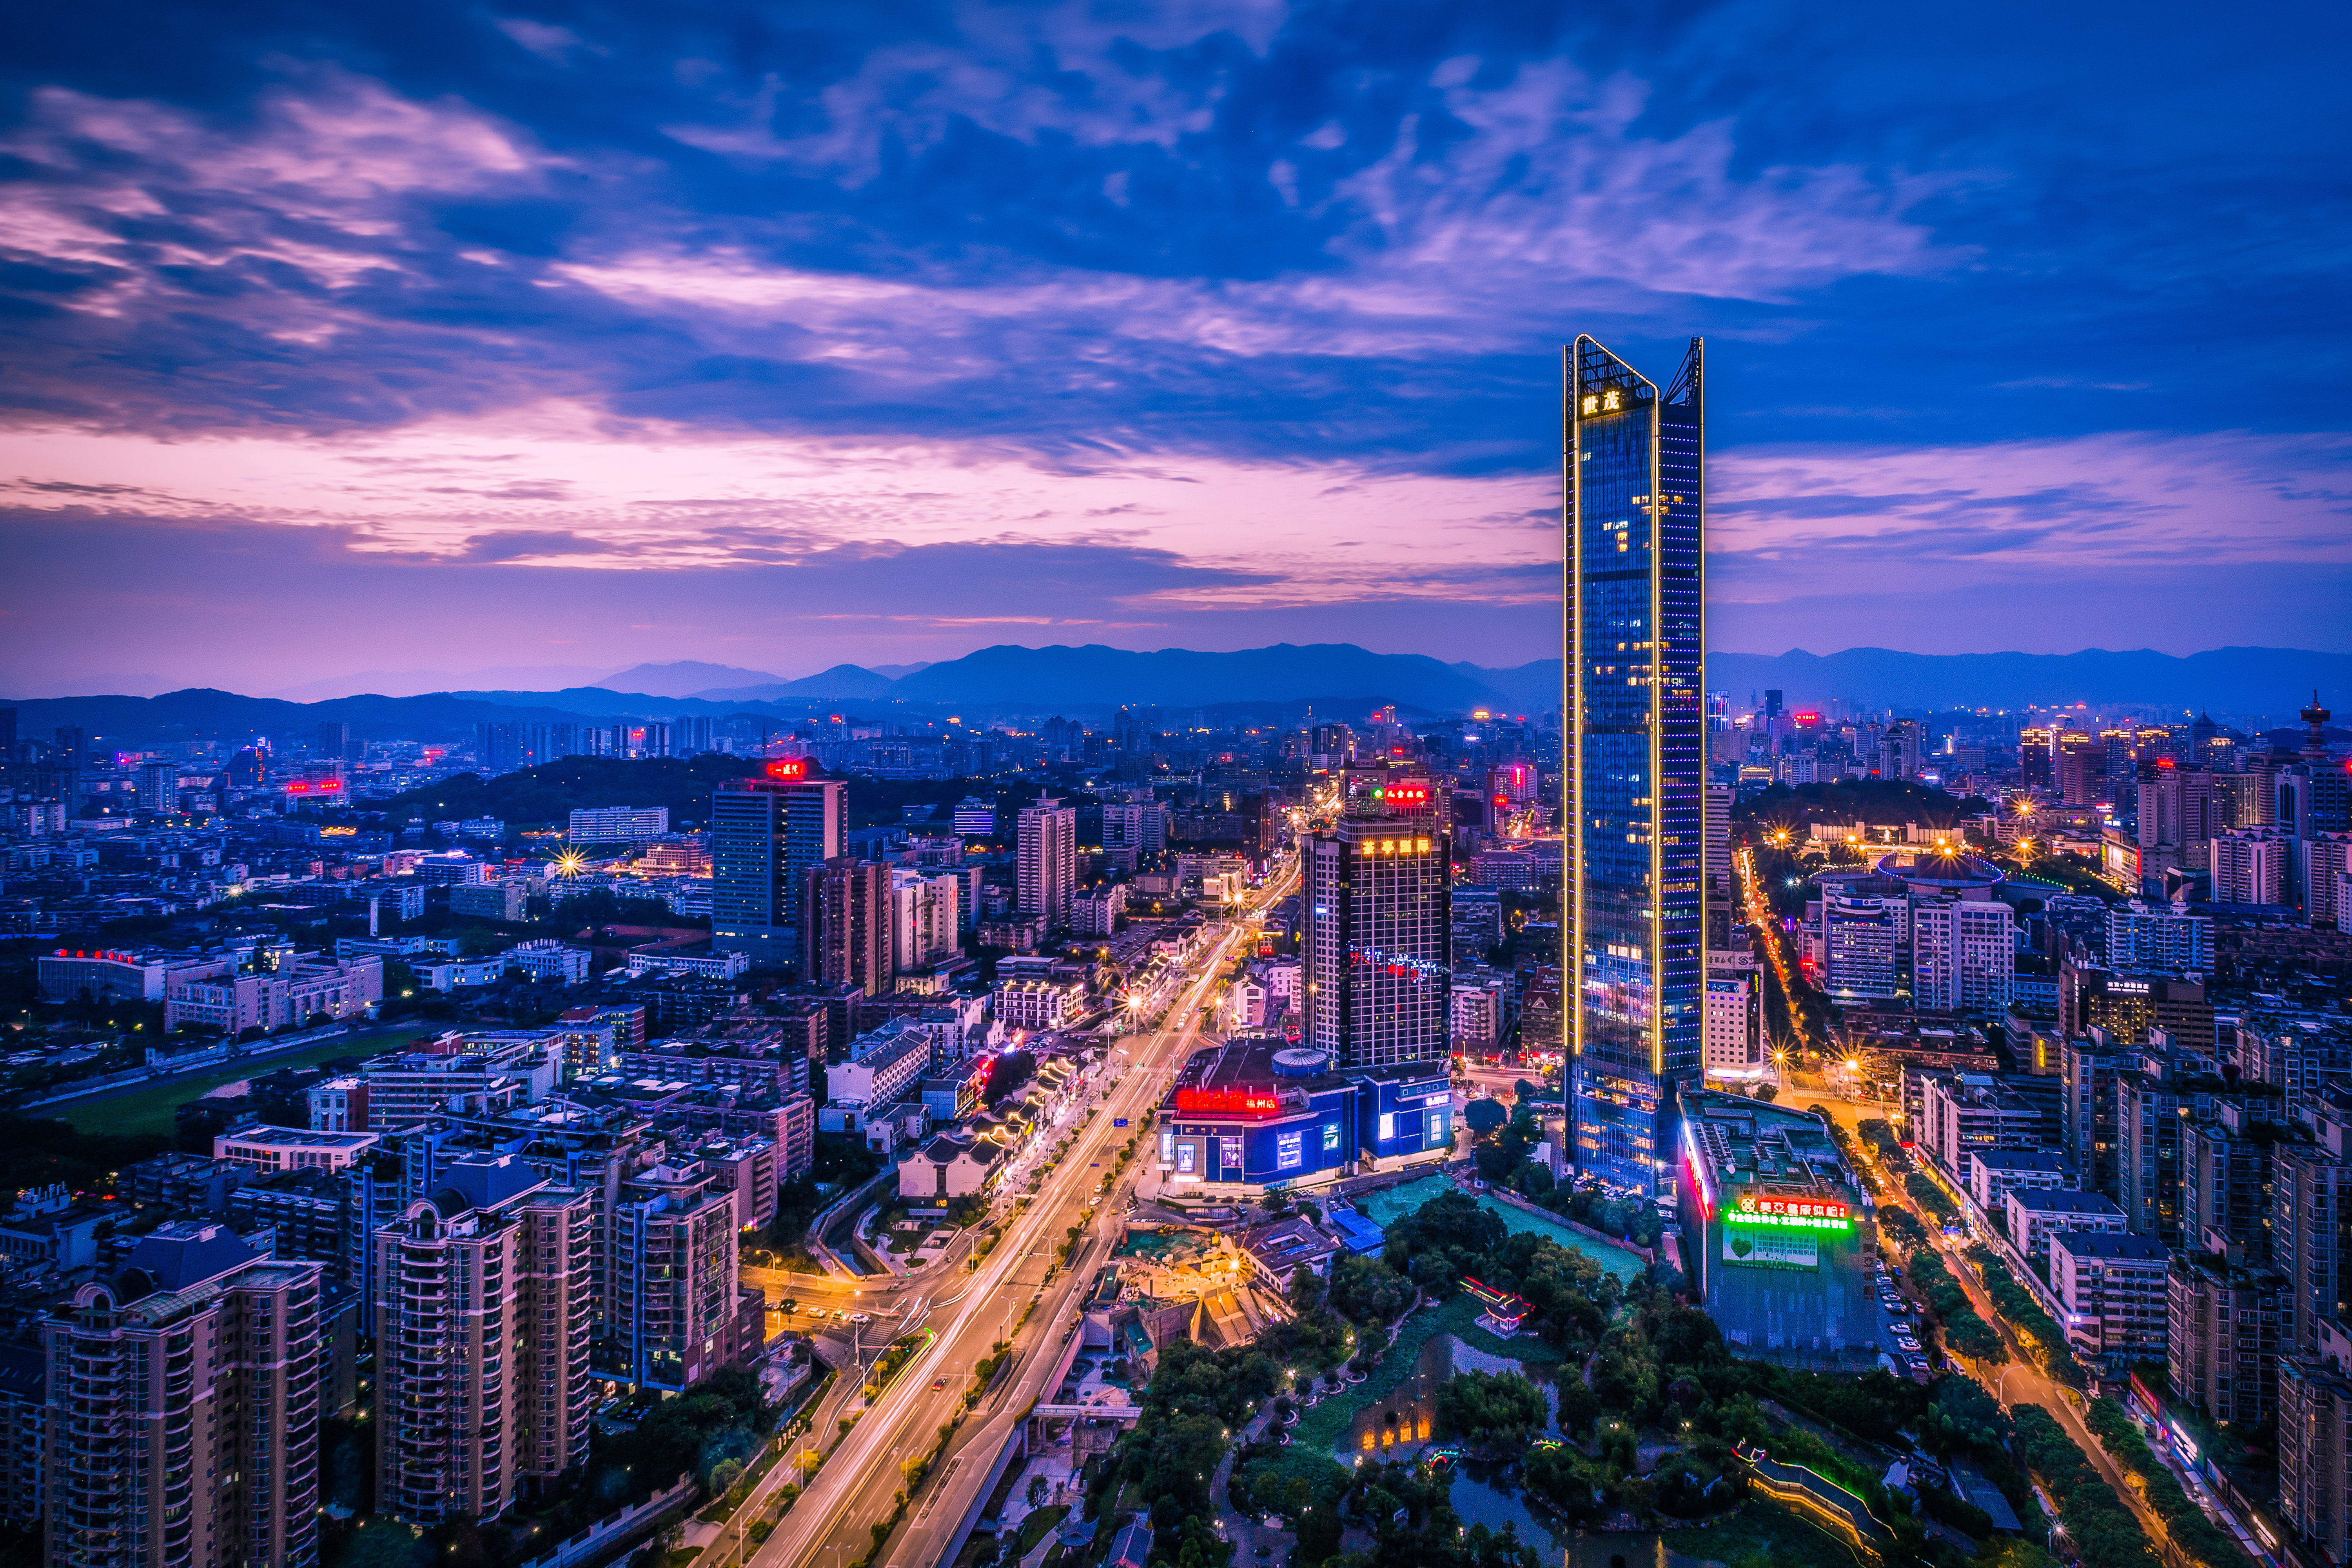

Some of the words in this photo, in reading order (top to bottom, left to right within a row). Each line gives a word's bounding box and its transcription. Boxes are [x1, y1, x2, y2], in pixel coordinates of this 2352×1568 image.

[1582, 390, 1620, 415] 世茂
[1363, 839, 1429, 855] 茶亭国际
[1179, 1091, 1243, 1110] 居然之家
[1246, 1099, 1275, 1109] 福州店
